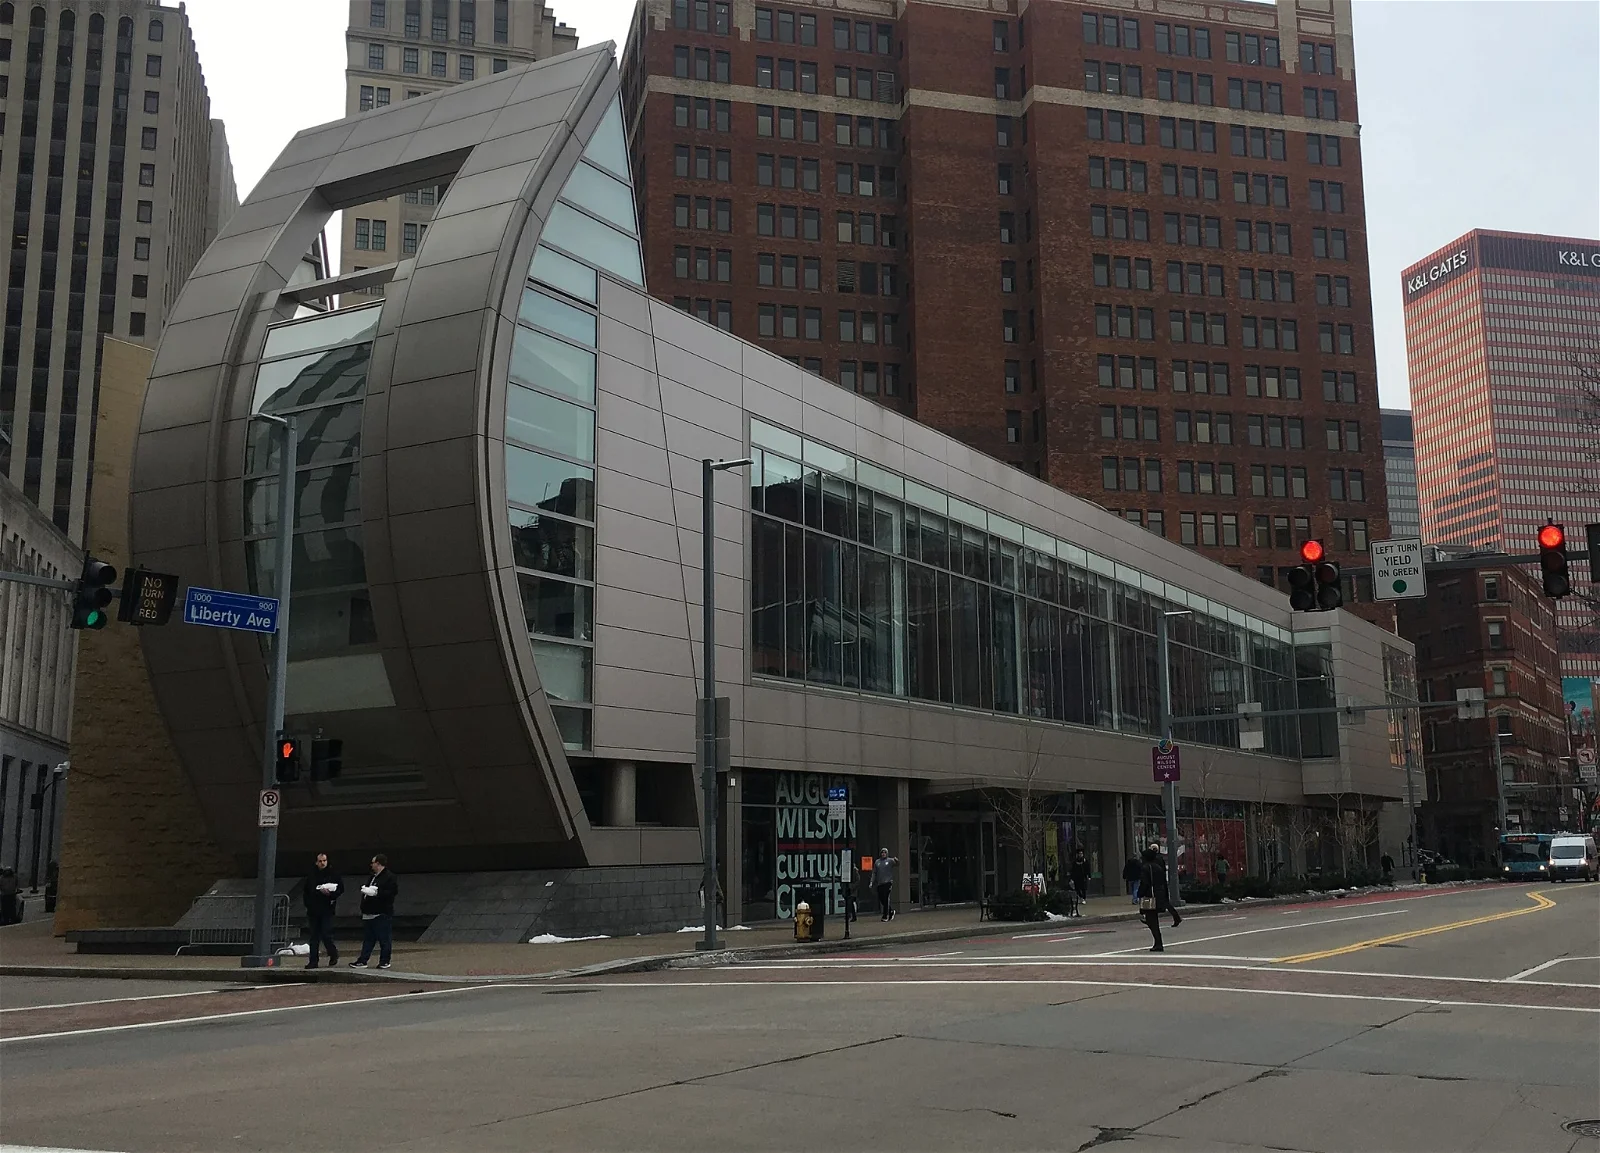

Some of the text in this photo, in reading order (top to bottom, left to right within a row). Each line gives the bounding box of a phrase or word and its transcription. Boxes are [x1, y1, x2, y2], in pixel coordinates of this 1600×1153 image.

[1558, 250, 1589, 267] K&L
[1408, 249, 1467, 295] K&L GATES
[1375, 543, 1418, 555] LEFT TURN
[1383, 554, 1412, 567] YIELD
[1378, 566, 1419, 578] ON GREEN
[144, 576, 163, 588] NO
[140, 589, 165, 599] TURN
[193, 592, 212, 603] 1000
[143, 599, 157, 609] ON
[258, 601, 273, 611] 900
[138, 608, 158, 619] RED
[190, 604, 271, 628] Liberty Ave
[776, 807, 857, 840] WILSON
[776, 852, 842, 880] CULTUR
